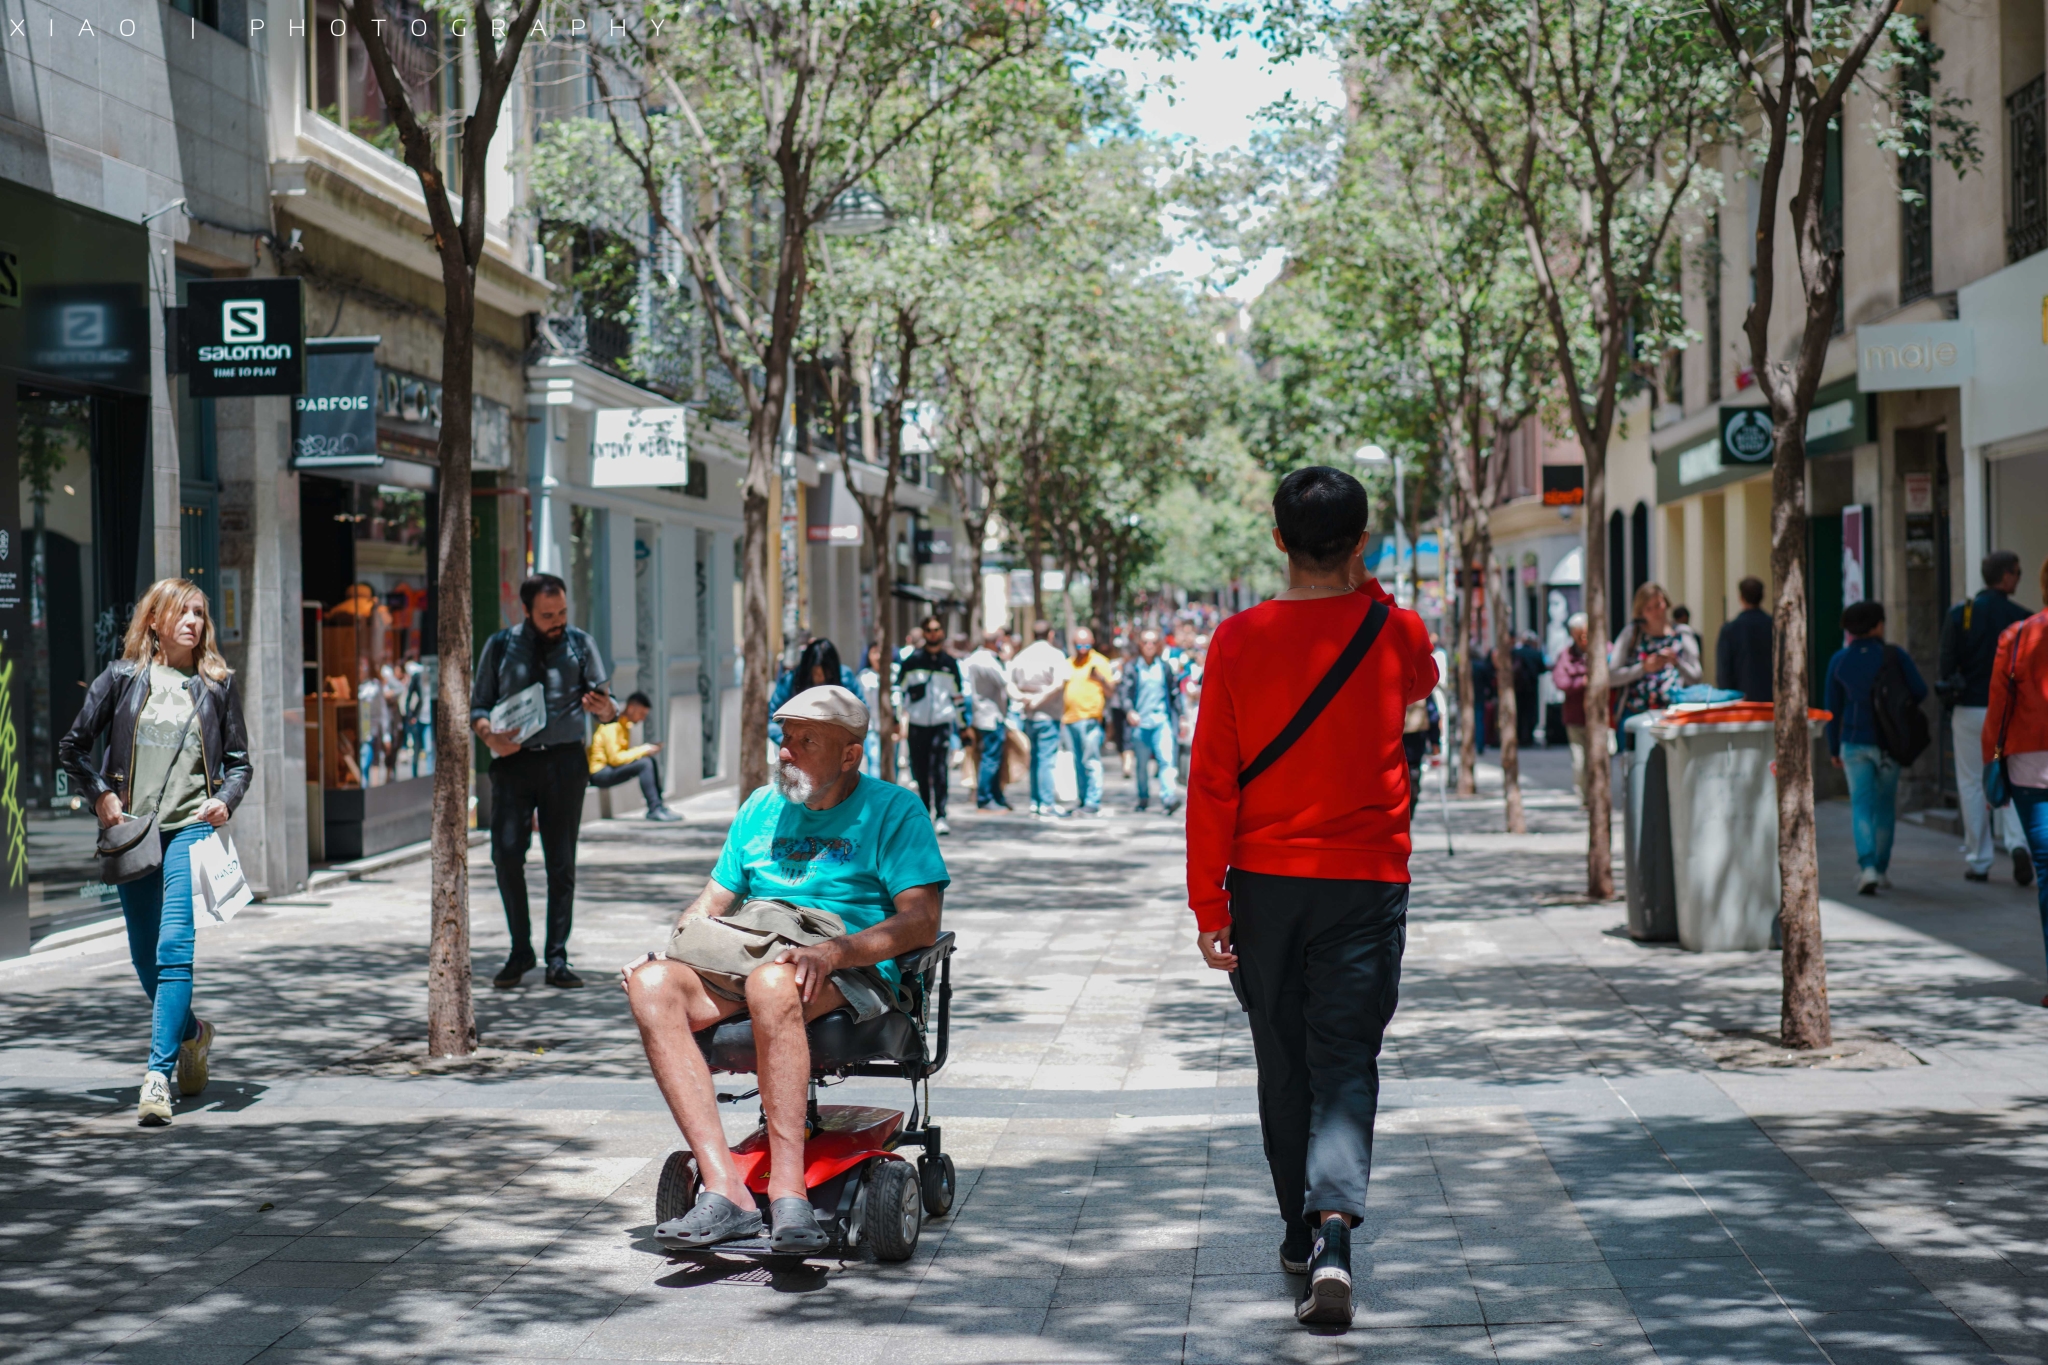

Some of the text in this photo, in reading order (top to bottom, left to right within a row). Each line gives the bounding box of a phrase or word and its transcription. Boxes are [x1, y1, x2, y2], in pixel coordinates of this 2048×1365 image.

[198, 344, 292, 361] salomon
[1866, 336, 1958, 374] maje
[213, 366, 277, 378] TIME TO PLAY
[296, 396, 369, 411] PARFOIS
